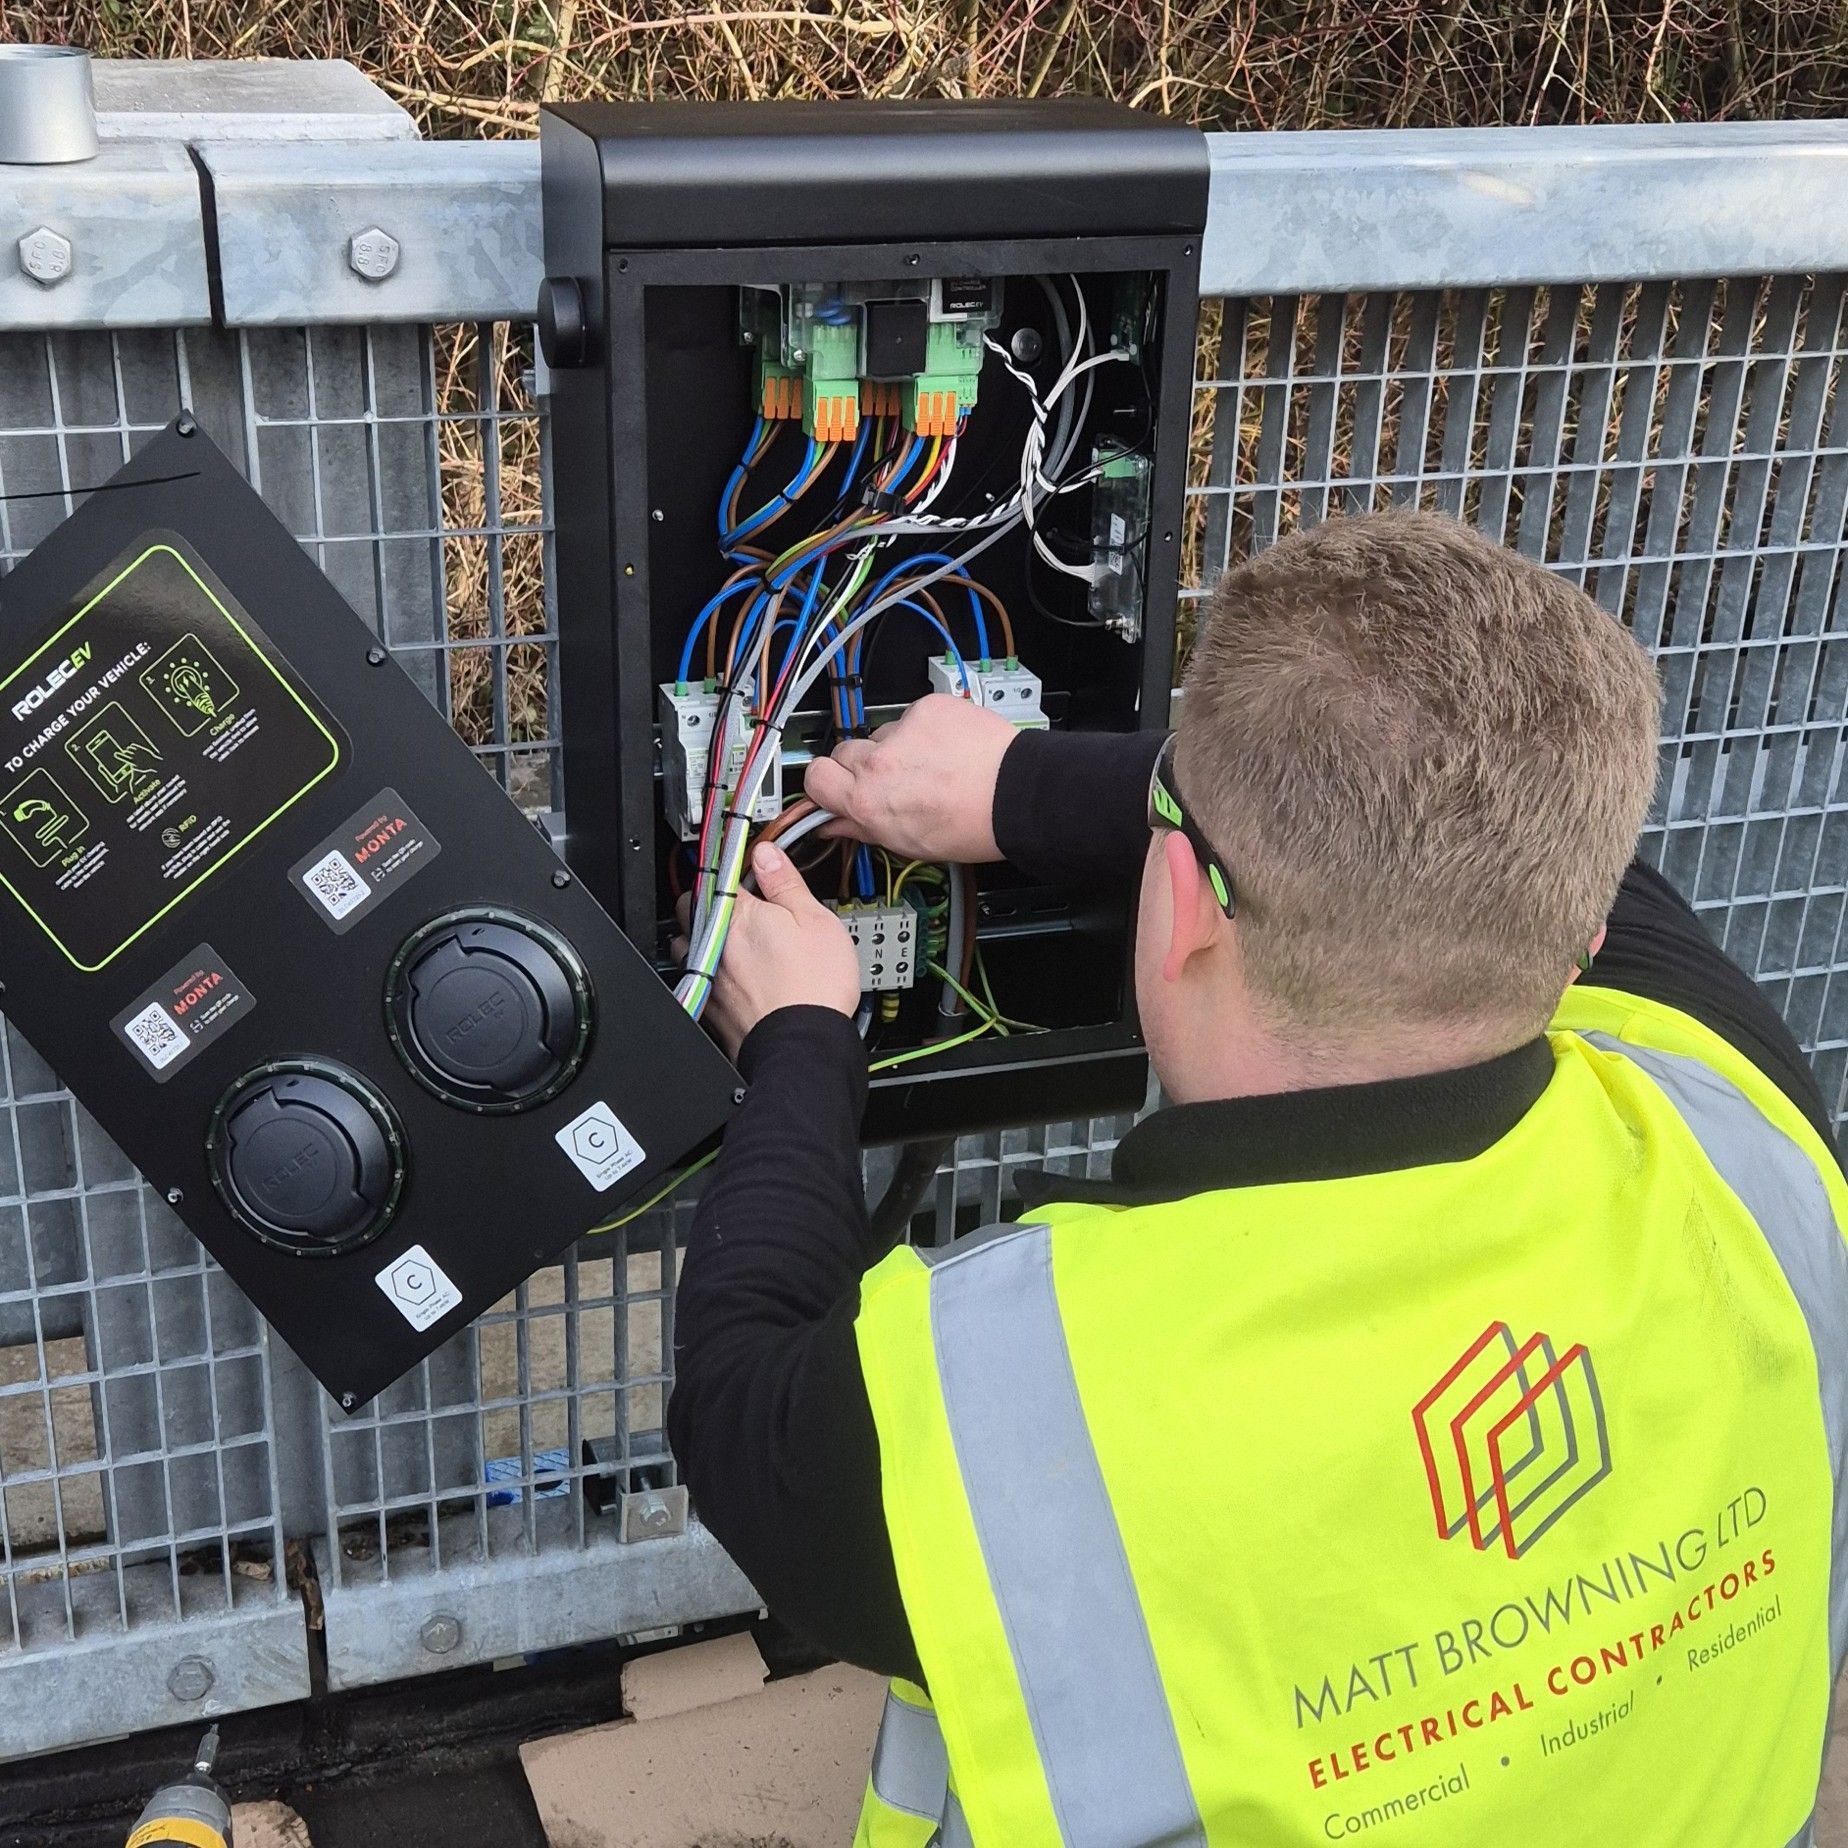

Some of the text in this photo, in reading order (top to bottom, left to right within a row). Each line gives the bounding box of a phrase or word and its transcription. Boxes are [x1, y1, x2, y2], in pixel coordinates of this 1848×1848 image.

[11, 641, 93, 722] ROLECEV
[3, 639, 152, 774] TO CHARGE YOUR VEHICLE:
[208, 711, 237, 737] Charge
[131, 776, 162, 805] Activate
[178, 813, 198, 832] RFID
[355, 817, 408, 863] MONTA
[875, 947, 907, 958] N E
[173, 971, 224, 1015] MONTA
[444, 990, 505, 1045] ROLEC
[588, 1131, 605, 1148] C
[406, 1274, 423, 1290] C
[1293, 1487, 1767, 1729] MATT BROWNING LTD
[1308, 1548, 1777, 1790] ELECTRICAL CONTRACTORS
[1324, 1594, 1783, 1840] Commercial Industrial Residential
